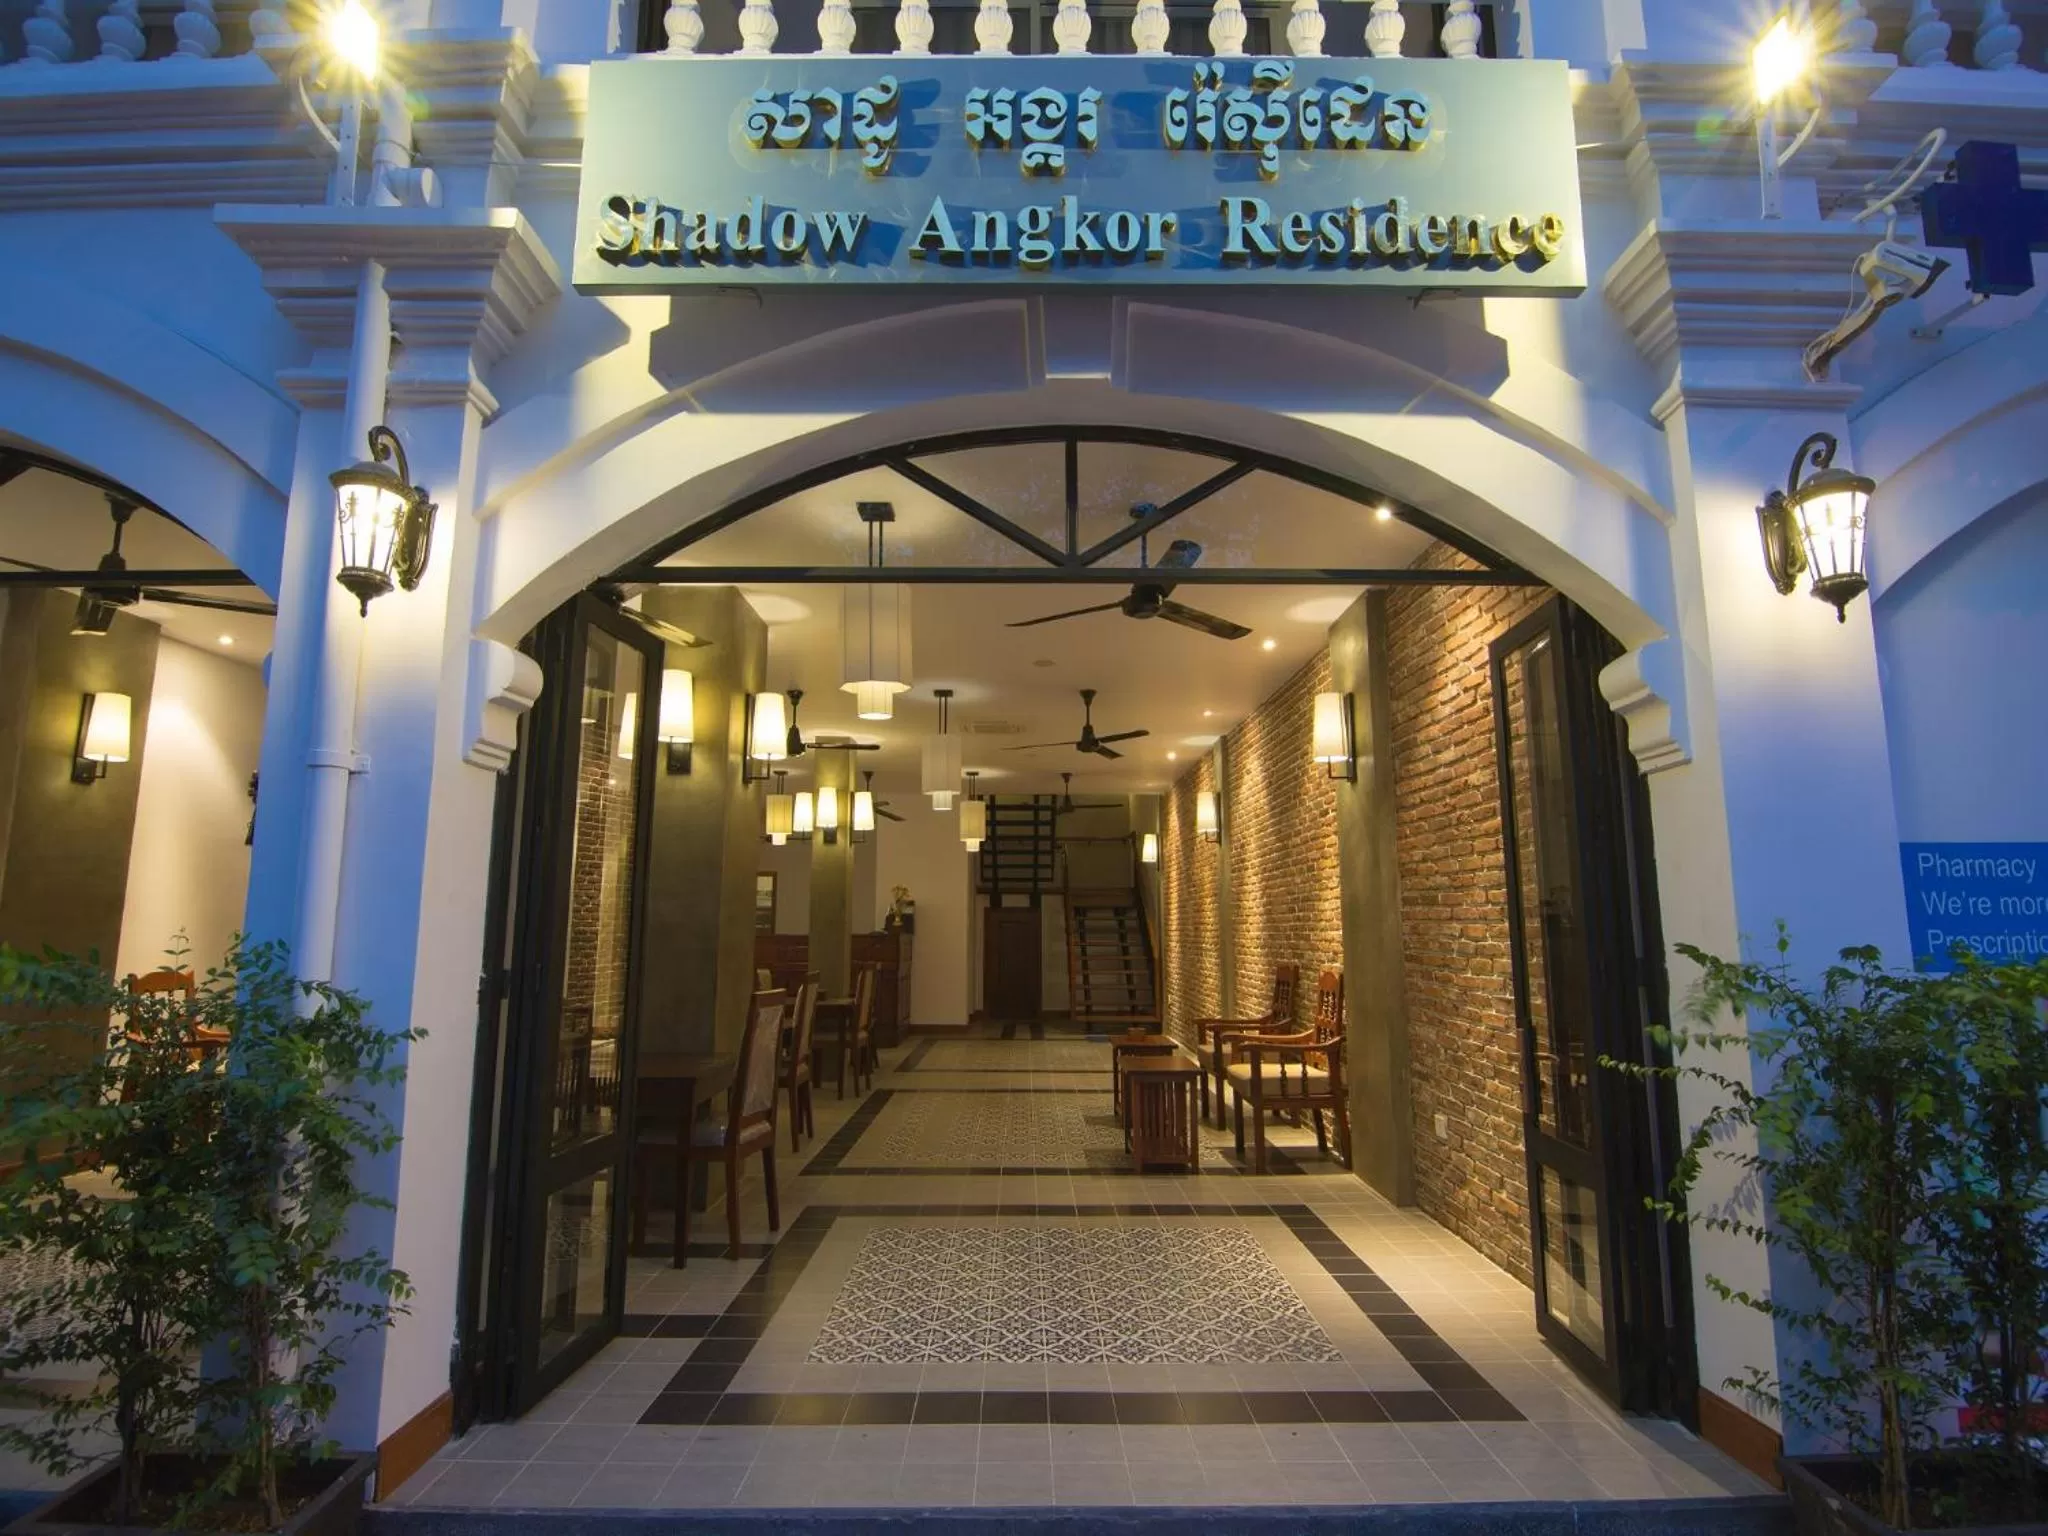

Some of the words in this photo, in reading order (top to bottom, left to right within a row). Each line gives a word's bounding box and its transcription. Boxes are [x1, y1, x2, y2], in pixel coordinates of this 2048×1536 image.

[965, 86, 1102, 170] អង្គរ
[598, 193, 867, 253] Shadow
[909, 195, 1178, 264] Angkor
[1221, 195, 1566, 261] Residence
[1918, 852, 2036, 884] Pharmacy
[1921, 891, 1992, 916] We're
[1999, 896, 2048, 915] mor
